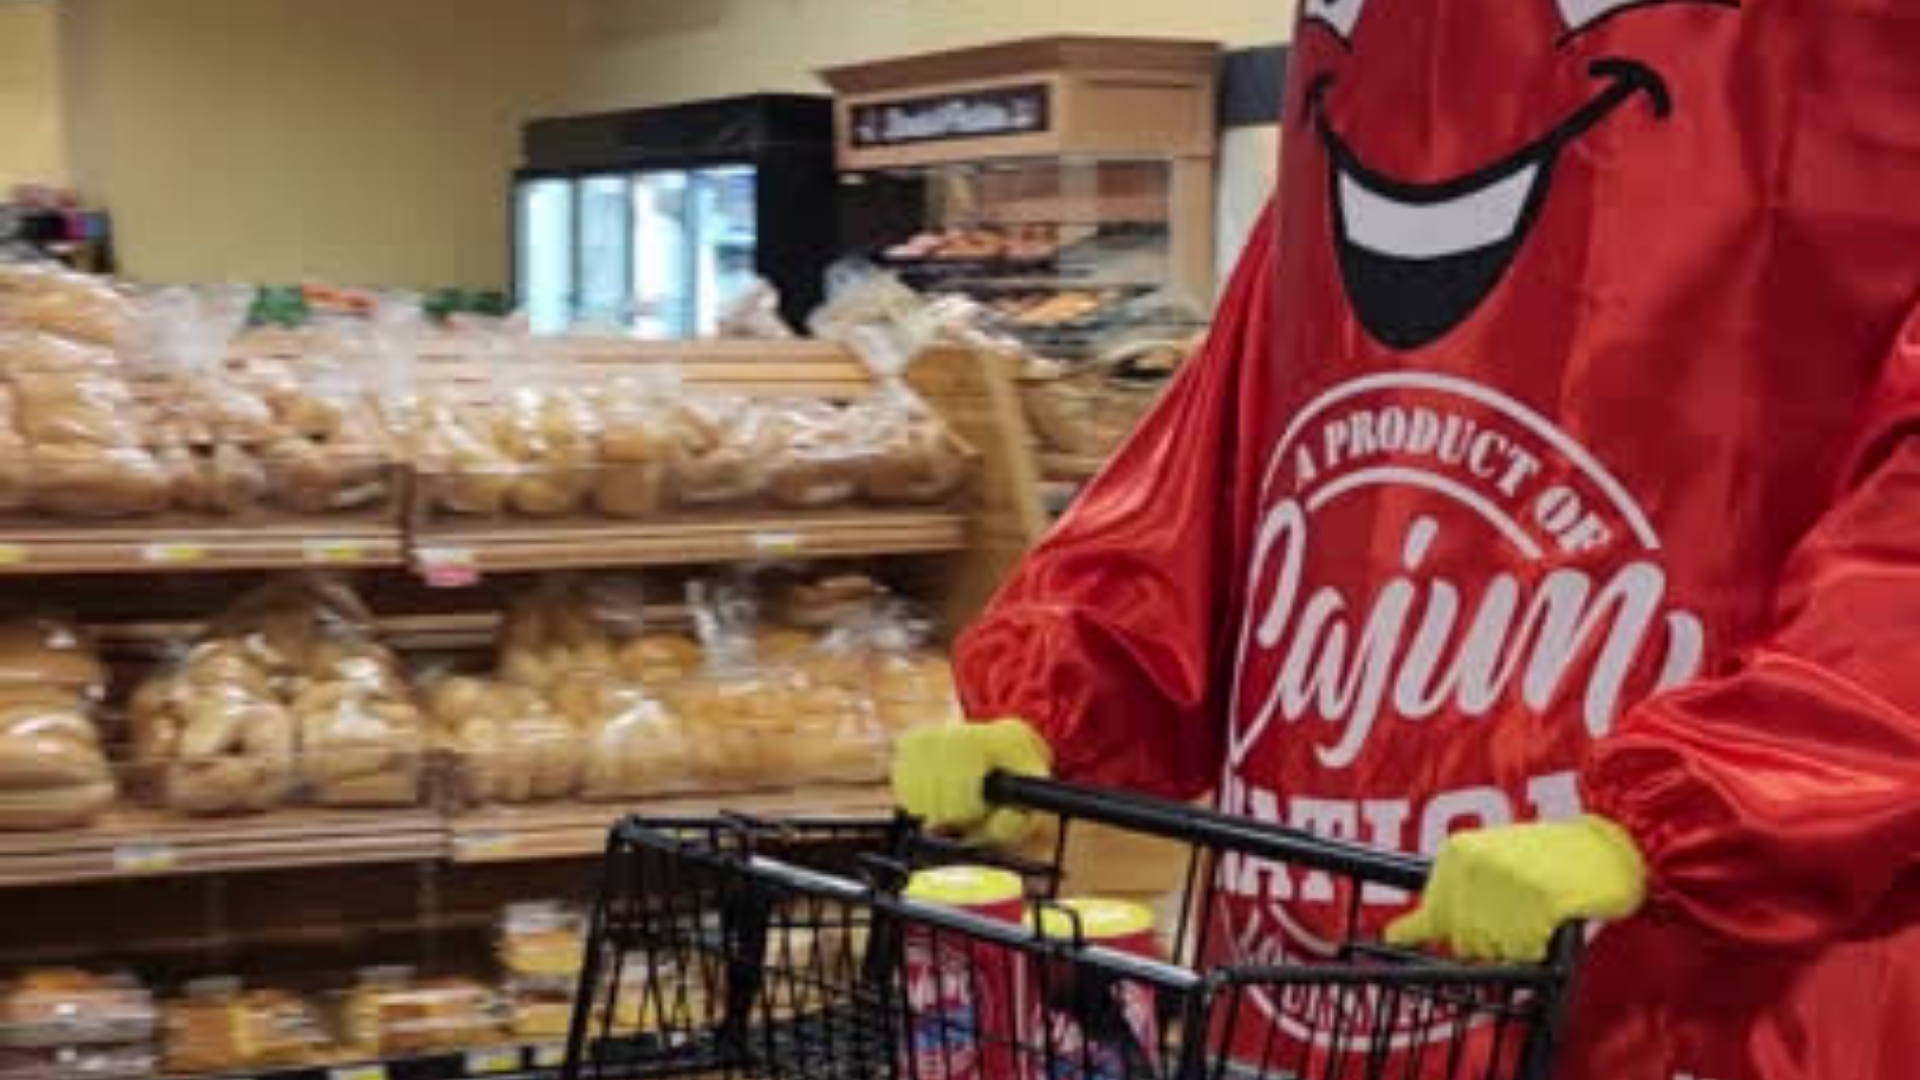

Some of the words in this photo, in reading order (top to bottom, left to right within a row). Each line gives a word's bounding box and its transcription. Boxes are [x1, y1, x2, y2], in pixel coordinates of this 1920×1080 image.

[1295, 443, 1316, 490] A
[1324, 405, 1541, 497] PRODUCT
[1535, 485, 1612, 552] OF
[1229, 499, 1703, 768] Cajun
